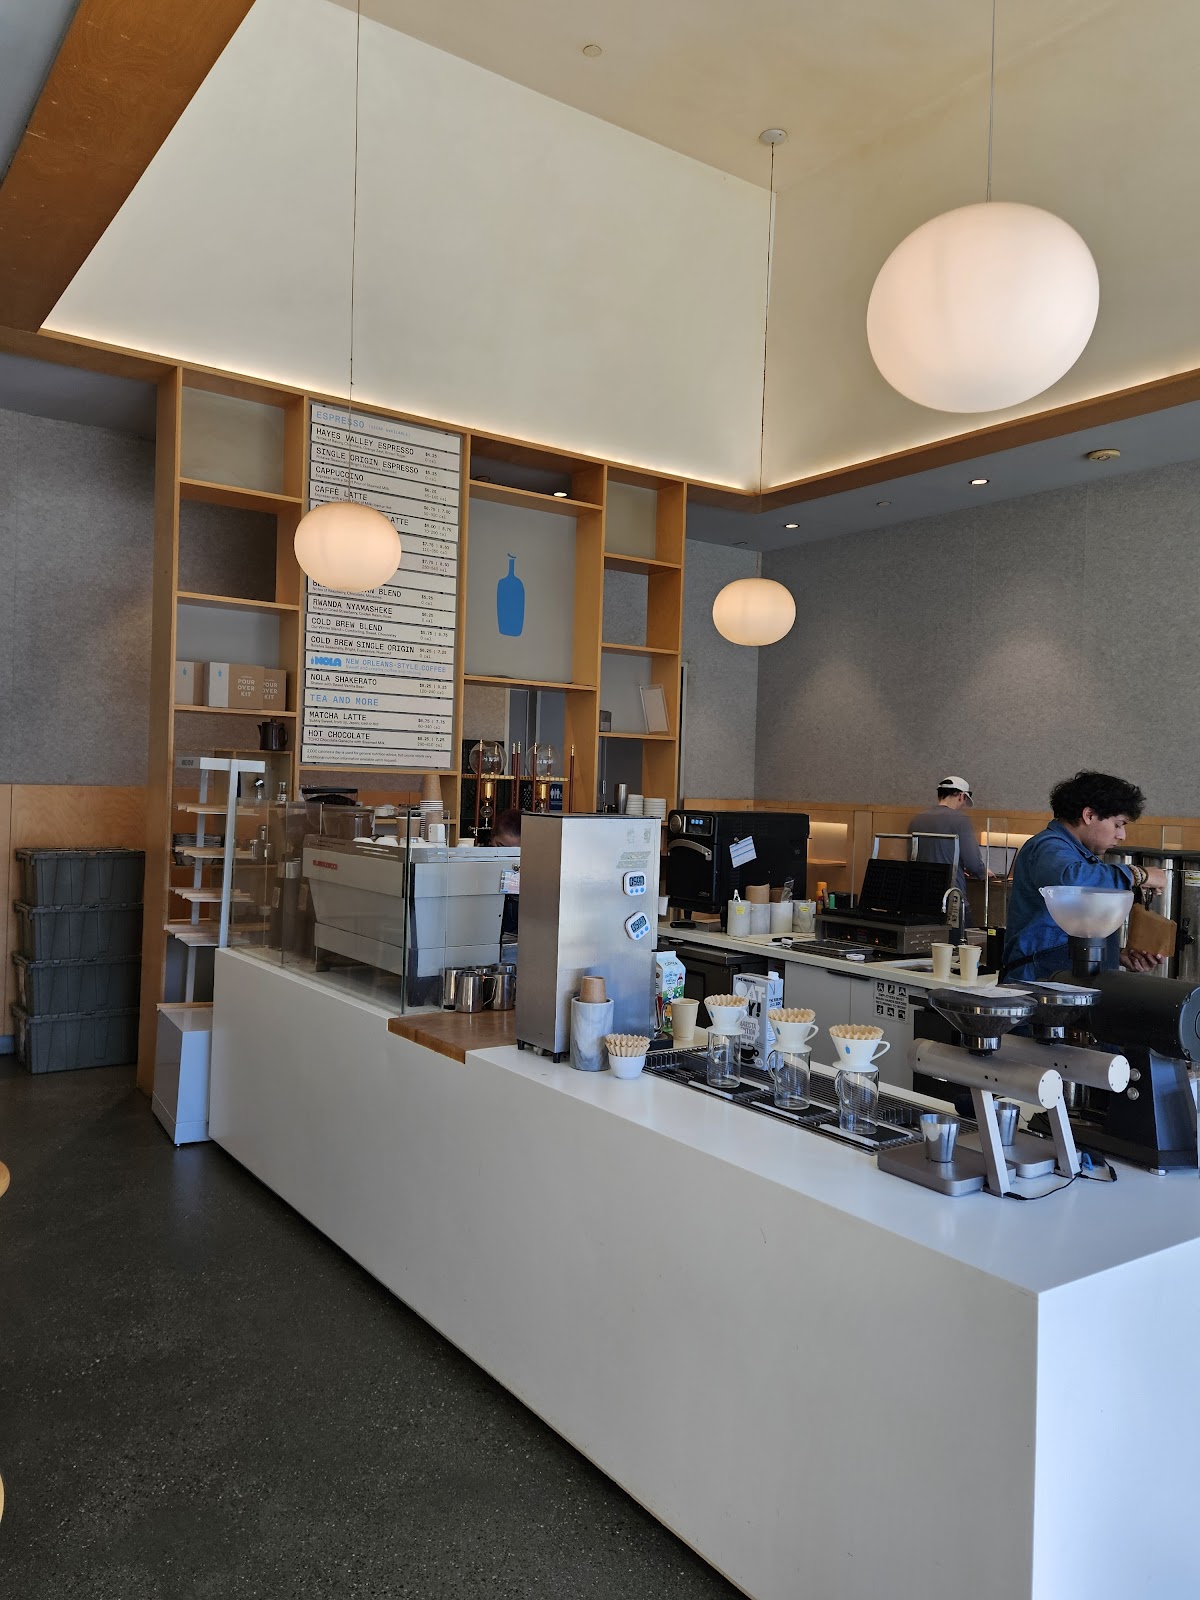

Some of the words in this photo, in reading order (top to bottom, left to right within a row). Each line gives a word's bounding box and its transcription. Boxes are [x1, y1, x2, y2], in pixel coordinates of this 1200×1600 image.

[317, 411, 364, 428] ESPRESSO
[317, 428, 341, 440] HAYES
[346, 435, 373, 447] VALLEY
[378, 442, 414, 455] ESPRESSO
[316, 448, 346, 460] SINGLE
[350, 454, 378, 466] ORIGIN
[383, 461, 419, 474] ESPRESSO
[316, 466, 364, 481] CAPPUCCINO
[315, 483, 339, 496] CAFFÈ
[344, 490, 368, 501] LATTE
[379, 589, 402, 598] BLEND
[313, 599, 342, 608] RWANDA
[346, 603, 392, 615] NYAMASHEKE
[311, 617, 331, 626] COLD
[336, 620, 355, 628] BREW
[360, 623, 383, 631] BLEND
[311, 636, 330, 644] COLD
[334, 639, 353, 647] BREW
[357, 641, 384, 650] SINGLE
[388, 644, 414, 653] ORIGIN
[315, 656, 342, 667] NOLA
[363, 660, 418, 670] ORLEANS-STYLE
[335, 676, 377, 685] SHAKERATO
[328, 731, 370, 739] CHOCOLATE
